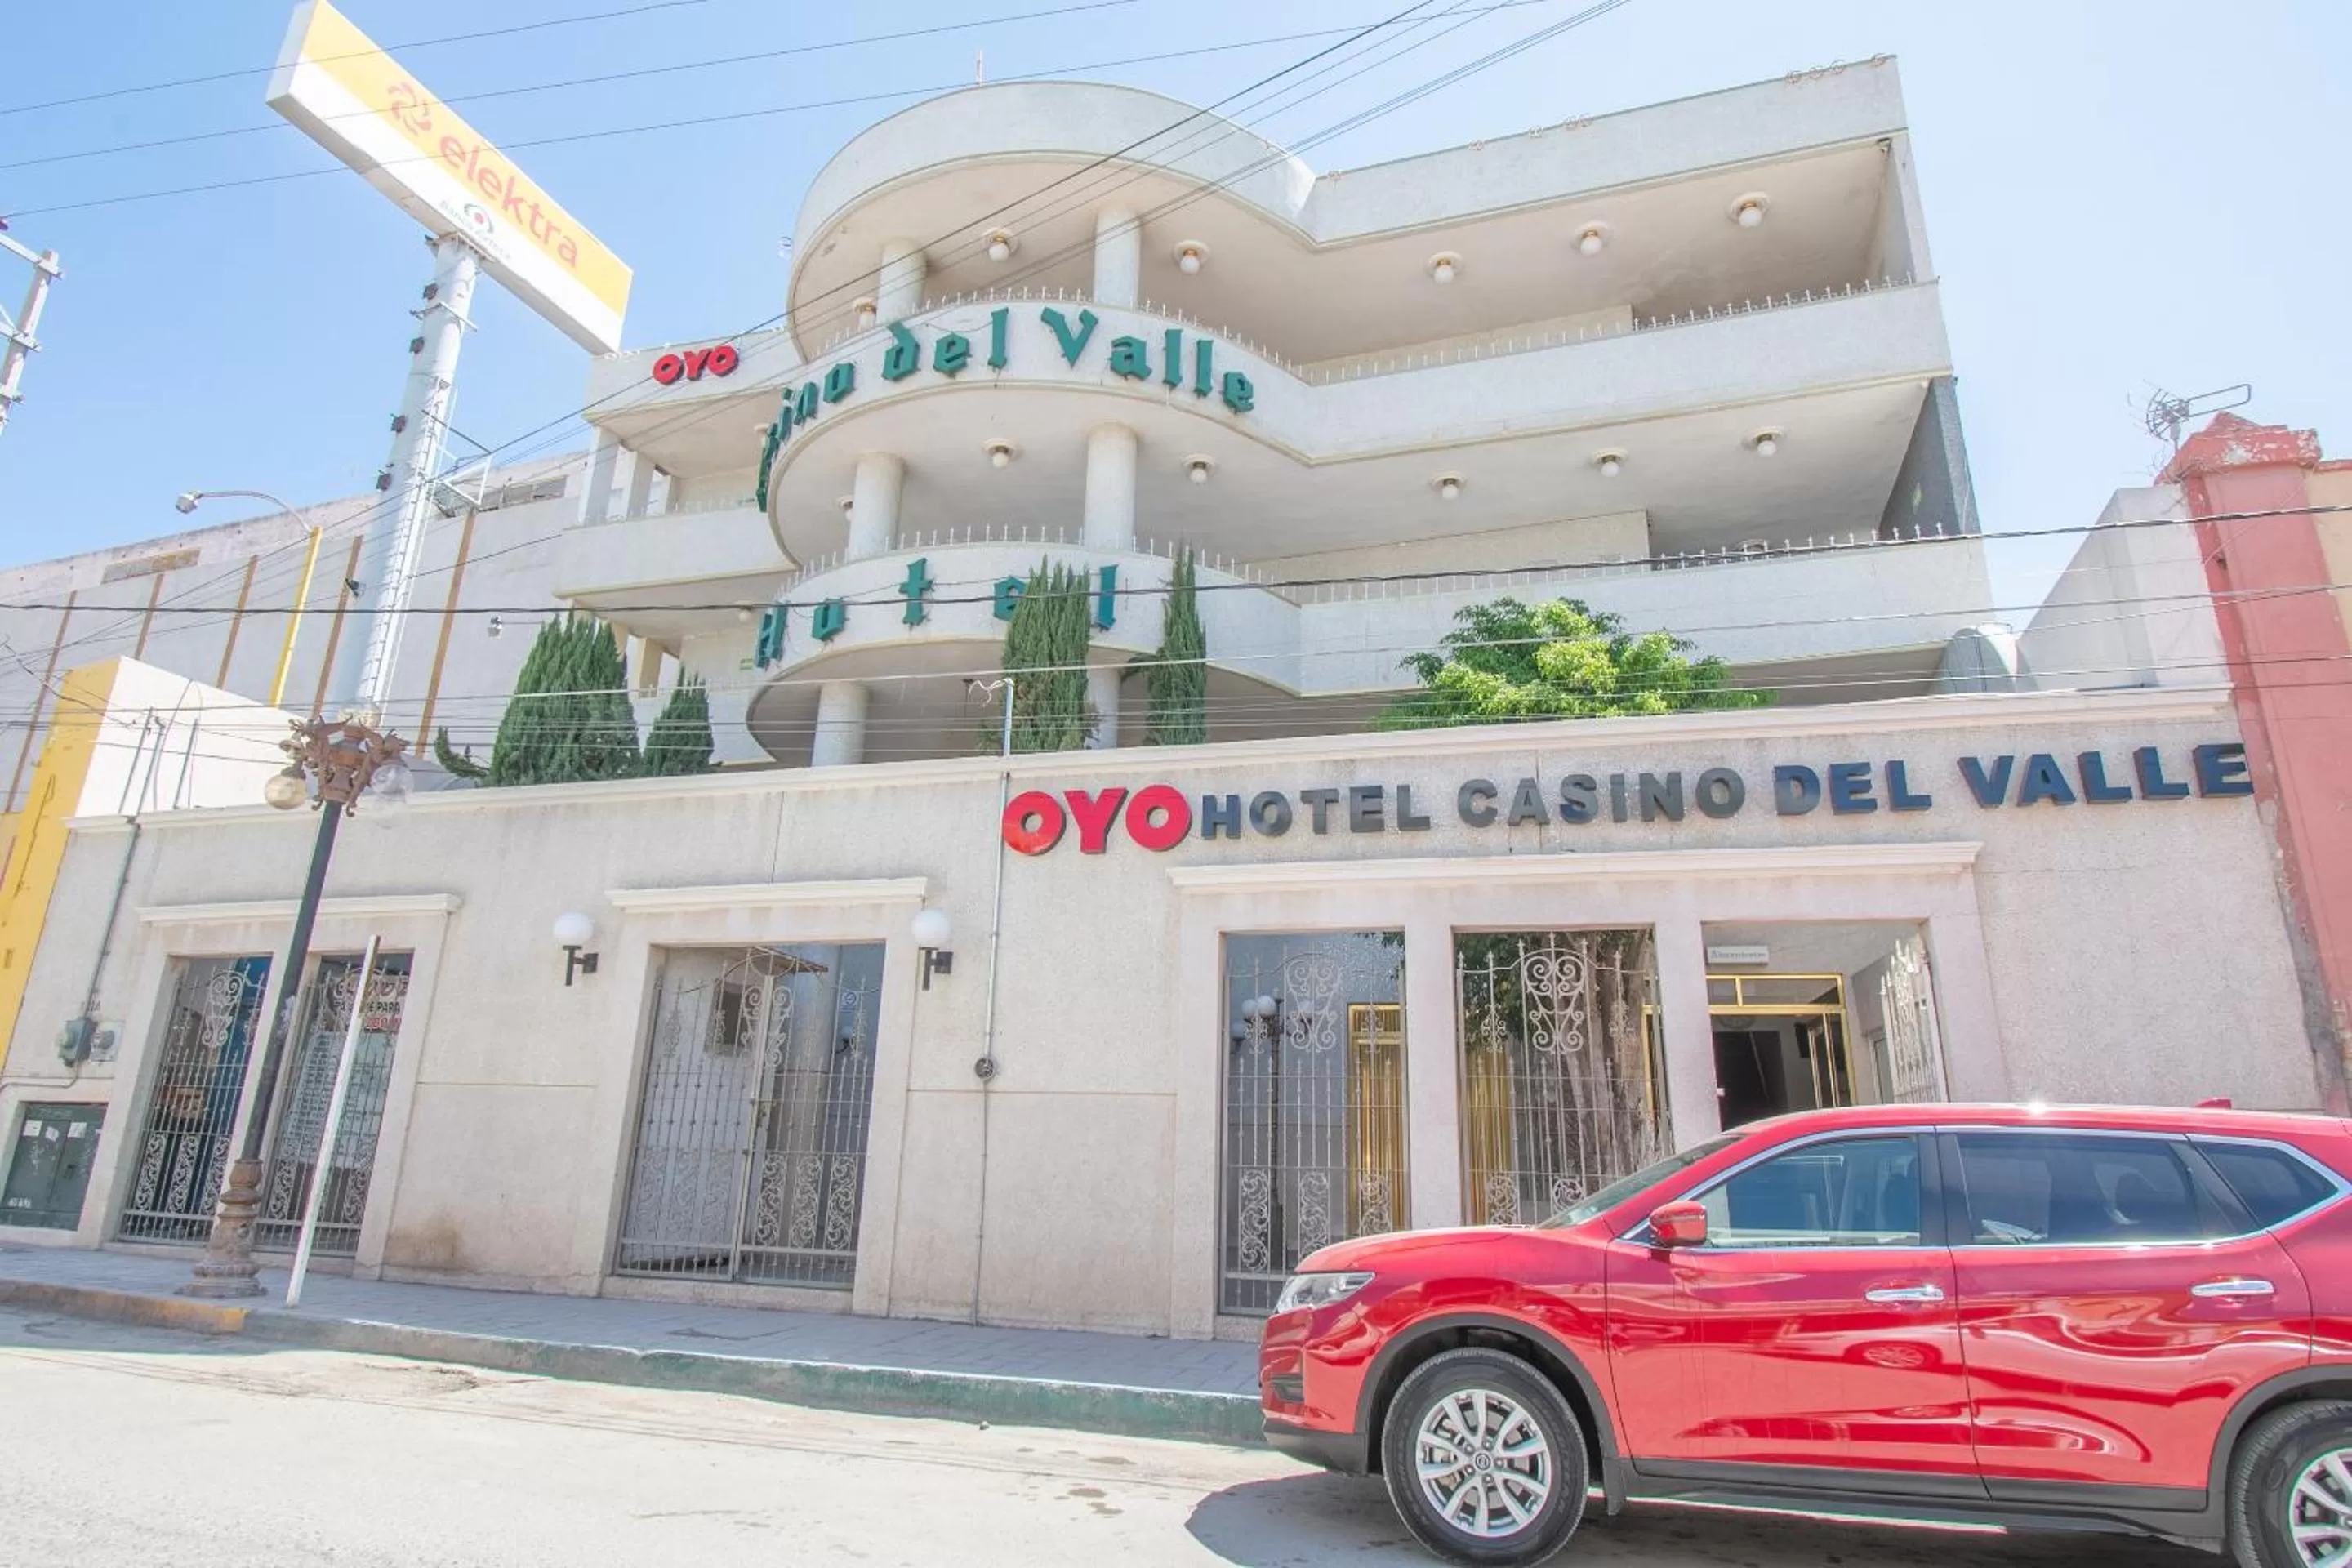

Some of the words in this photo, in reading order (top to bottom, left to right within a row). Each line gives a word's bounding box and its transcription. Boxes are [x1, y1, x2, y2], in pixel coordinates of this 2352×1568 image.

[439, 136, 578, 268] elektra
[652, 345, 739, 385] OYO
[881, 306, 1009, 382] del
[1040, 305, 1255, 413] Valle
[1003, 784, 1192, 856] OYO
[1200, 784, 1432, 841] HOTEL
[1457, 766, 1746, 827] CASINO
[1772, 760, 1933, 817] DEL
[1956, 742, 2255, 808] VALLE
